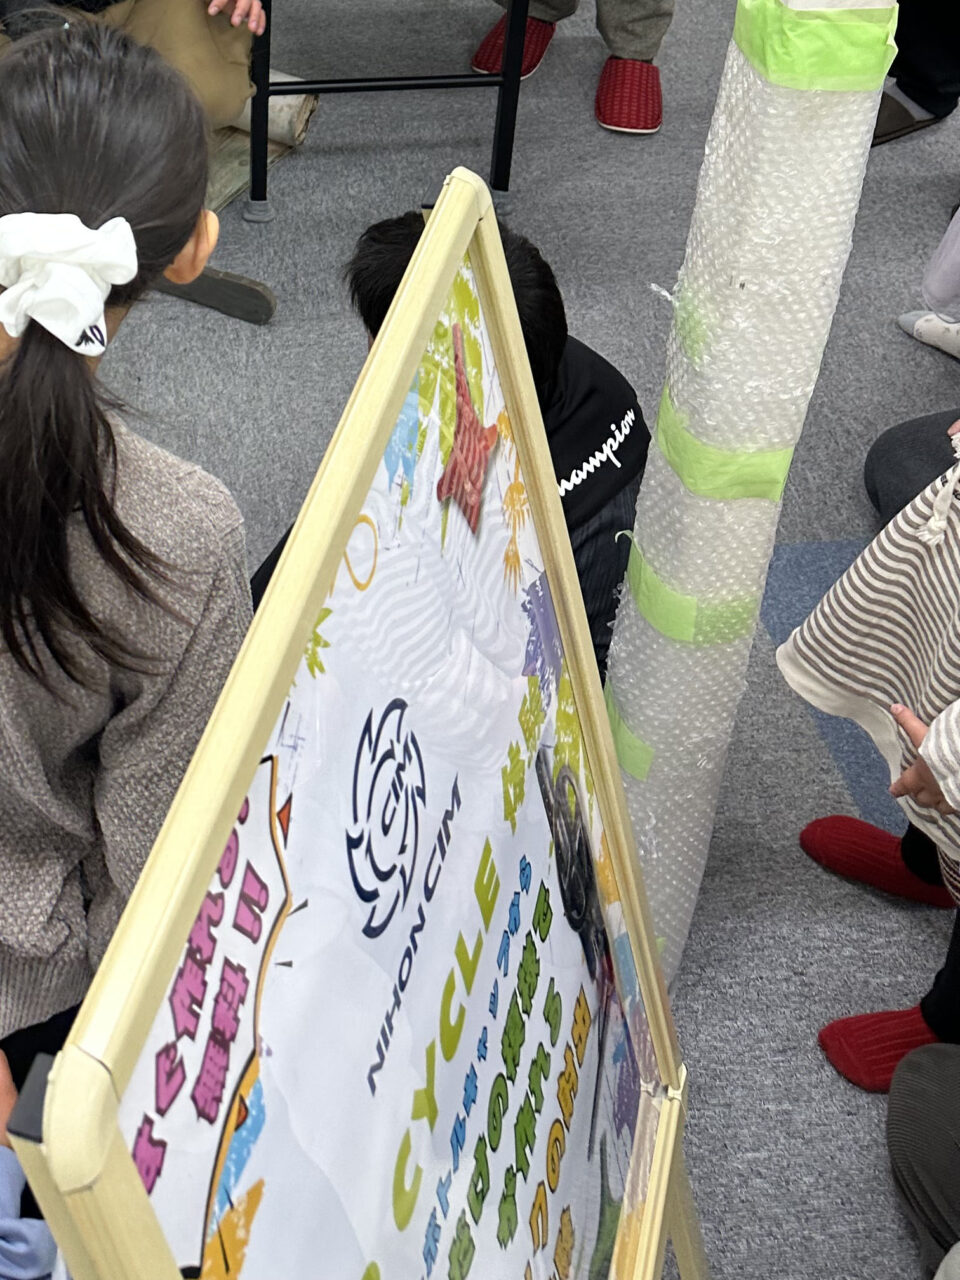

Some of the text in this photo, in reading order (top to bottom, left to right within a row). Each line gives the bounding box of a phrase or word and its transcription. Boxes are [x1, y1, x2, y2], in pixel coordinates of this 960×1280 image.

[367, 772, 462, 1097] NIHON CIM
[381, 739, 413, 837] CIM
[393, 838, 500, 1231] CYCLE
